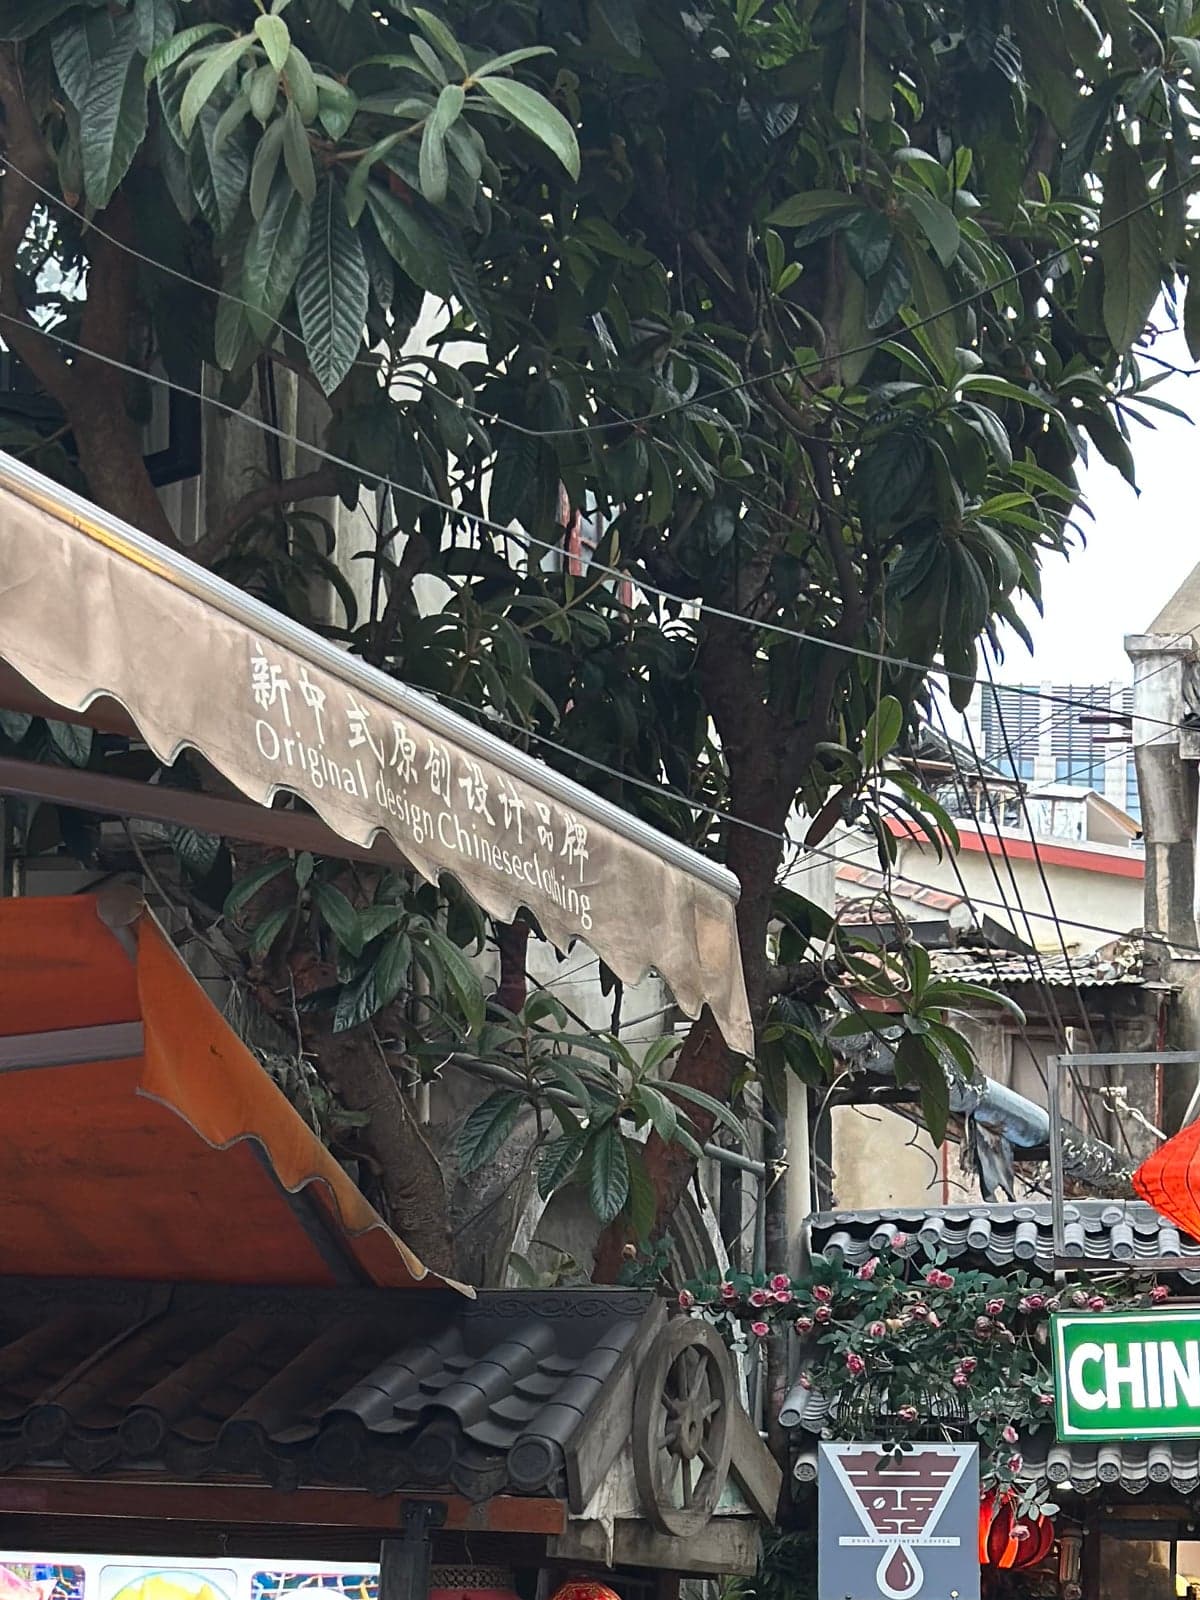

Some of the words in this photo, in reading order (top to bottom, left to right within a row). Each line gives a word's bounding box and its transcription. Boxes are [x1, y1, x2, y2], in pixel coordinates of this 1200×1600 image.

[250, 642, 590, 881] 新中式原创设计品牌
[256, 719, 369, 800] Original
[375, 770, 433, 844] design
